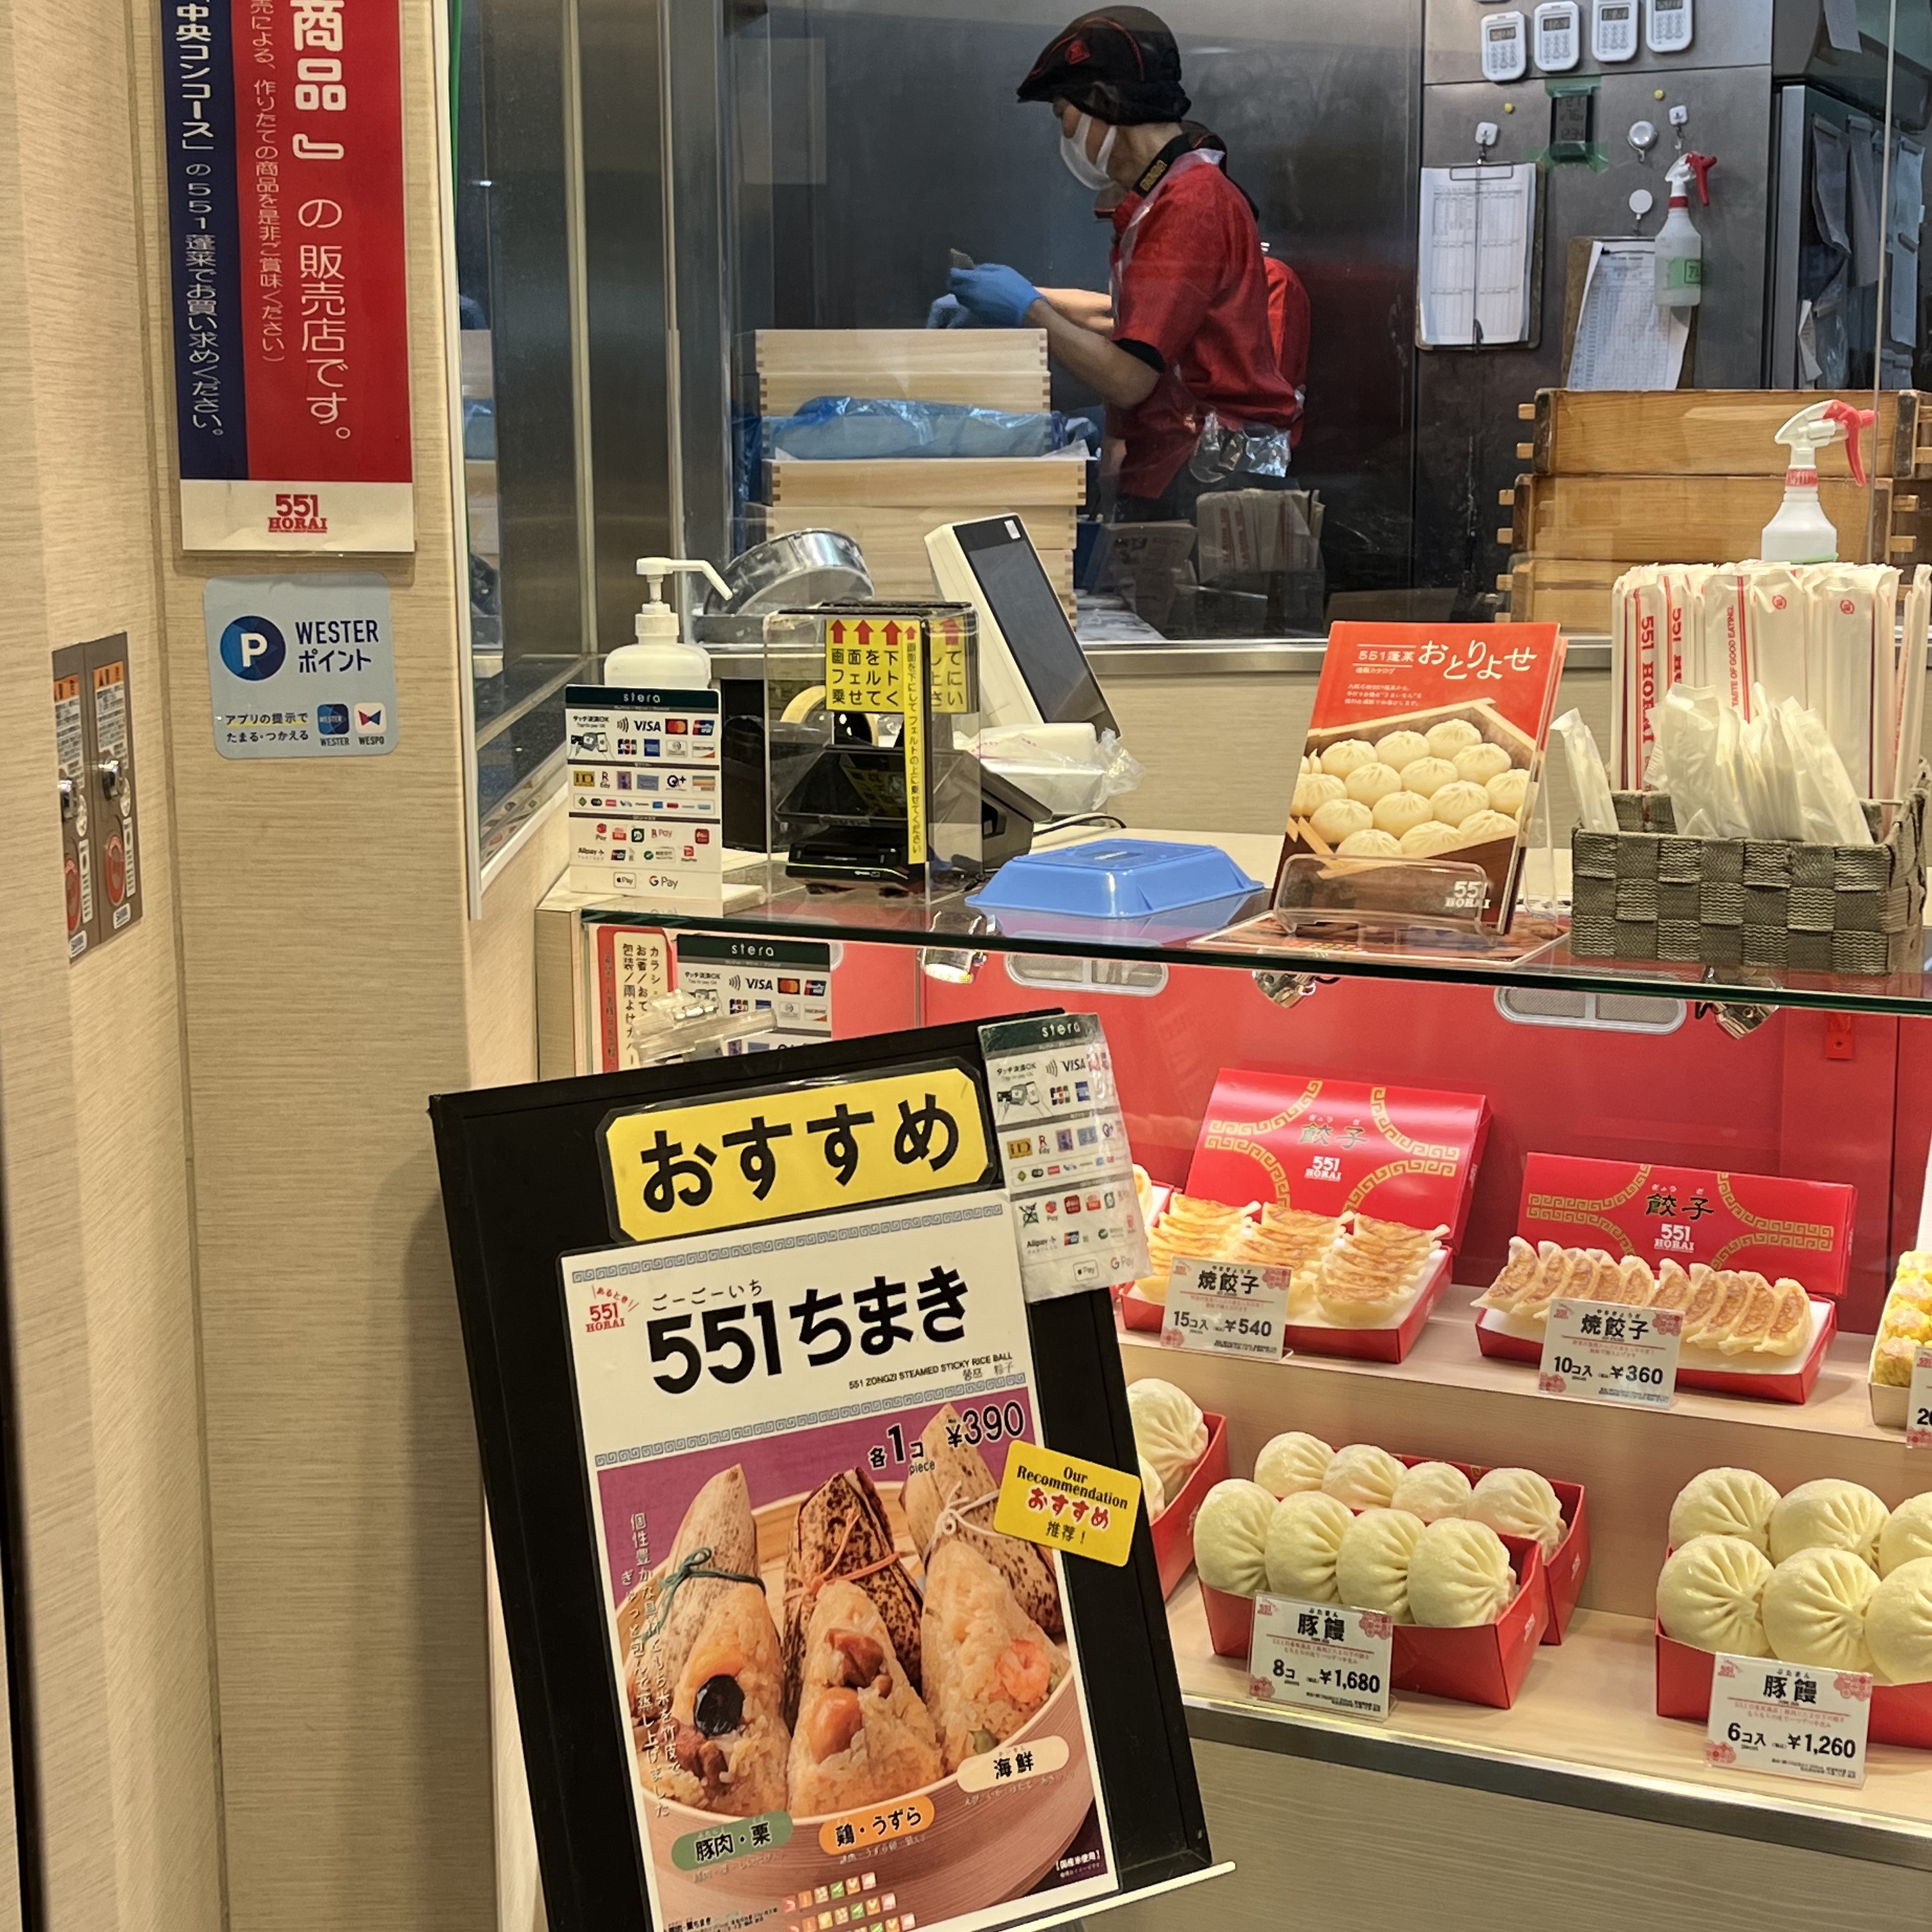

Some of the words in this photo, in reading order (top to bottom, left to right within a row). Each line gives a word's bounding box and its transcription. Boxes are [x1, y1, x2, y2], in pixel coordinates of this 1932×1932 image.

[176, 0, 224, 435] 中央コンコース」の551蓬莱でお買い求めください。
[276, 494, 318, 517] 551
[268, 517, 327, 530] HORAI
[295, 620, 379, 644] WESTER
[1642, 616, 1654, 650] 551
[241, 633, 268, 667] P
[298, 648, 371, 673] ポイント
[831, 648, 962, 666] 画面を下て
[1418, 640, 1537, 680] おとりよせ
[1728, 640, 1736, 666] GOOD
[831, 669, 963, 686] フェルト上に
[1729, 667, 1738, 678] OF
[624, 692, 661, 703] stera
[832, 689, 963, 706] 乗せてくさい
[1730, 681, 1738, 707] TASTE
[226, 712, 308, 724] アプリの提示で
[634, 720, 661, 732] VISA
[227, 730, 309, 743] たまる・つかえる
[320, 737, 349, 746] WESTER
[358, 735, 385, 746] WESPO
[661, 877, 678, 889] Pay
[732, 943, 774, 957] stera
[636, 945, 648, 1017] お箸／おて
[746, 978, 774, 990] VISA
[1041, 1022, 1080, 1038] stera
[1062, 1058, 1086, 1072] VISA
[640, 1093, 959, 1213] おすすめ
[1312, 1156, 1340, 1172] 551
[1646, 1193, 1714, 1220] 餃子
[1654, 1238, 1694, 1250] HORAI
[1661, 1223, 1690, 1241] 551
[1198, 1270, 1259, 1294] 焼餃子
[652, 1279, 762, 1311] ごーごーいち
[590, 1303, 618, 1321] 551
[1174, 1310, 1208, 1330] 15コ入
[1225, 1318, 1271, 1337] ¥540
[586, 1318, 625, 1332] HORAI
[646, 1265, 969, 1395] 551ちまき
[1581, 1314, 1649, 1340] 焼餃子
[849, 1381, 863, 1390] 551
[899, 1366, 939, 1381] STEAMED
[940, 1360, 970, 1372] STICKY
[972, 1355, 991, 1366] RICE
[993, 1352, 1013, 1362] BALL
[1554, 1356, 1593, 1377] 10コ入
[1610, 1365, 1663, 1385] ¥360
[946, 1402, 1024, 1448] ¥390
[870, 1423, 924, 1468] 各1コ
[909, 1461, 935, 1475] piece
[1063, 1466, 1088, 1484] Our
[1016, 1465, 1128, 1510] Recommendation
[1027, 1487, 1111, 1529] おすすめ
[1298, 1613, 1345, 1642] 豚饅
[1273, 1659, 1296, 1679] 8コ
[1319, 1668, 1381, 1693] ¥1,680
[1763, 1675, 1817, 1704] 豚饅
[1728, 1722, 1767, 1747] 6コ入
[1788, 1733, 1856, 1758] ¥1,260
[993, 1751, 1034, 1779] 海鮮
[835, 1807, 921, 1847] 鶏・うずら
[695, 1822, 770, 1862] 豚肉・栗
